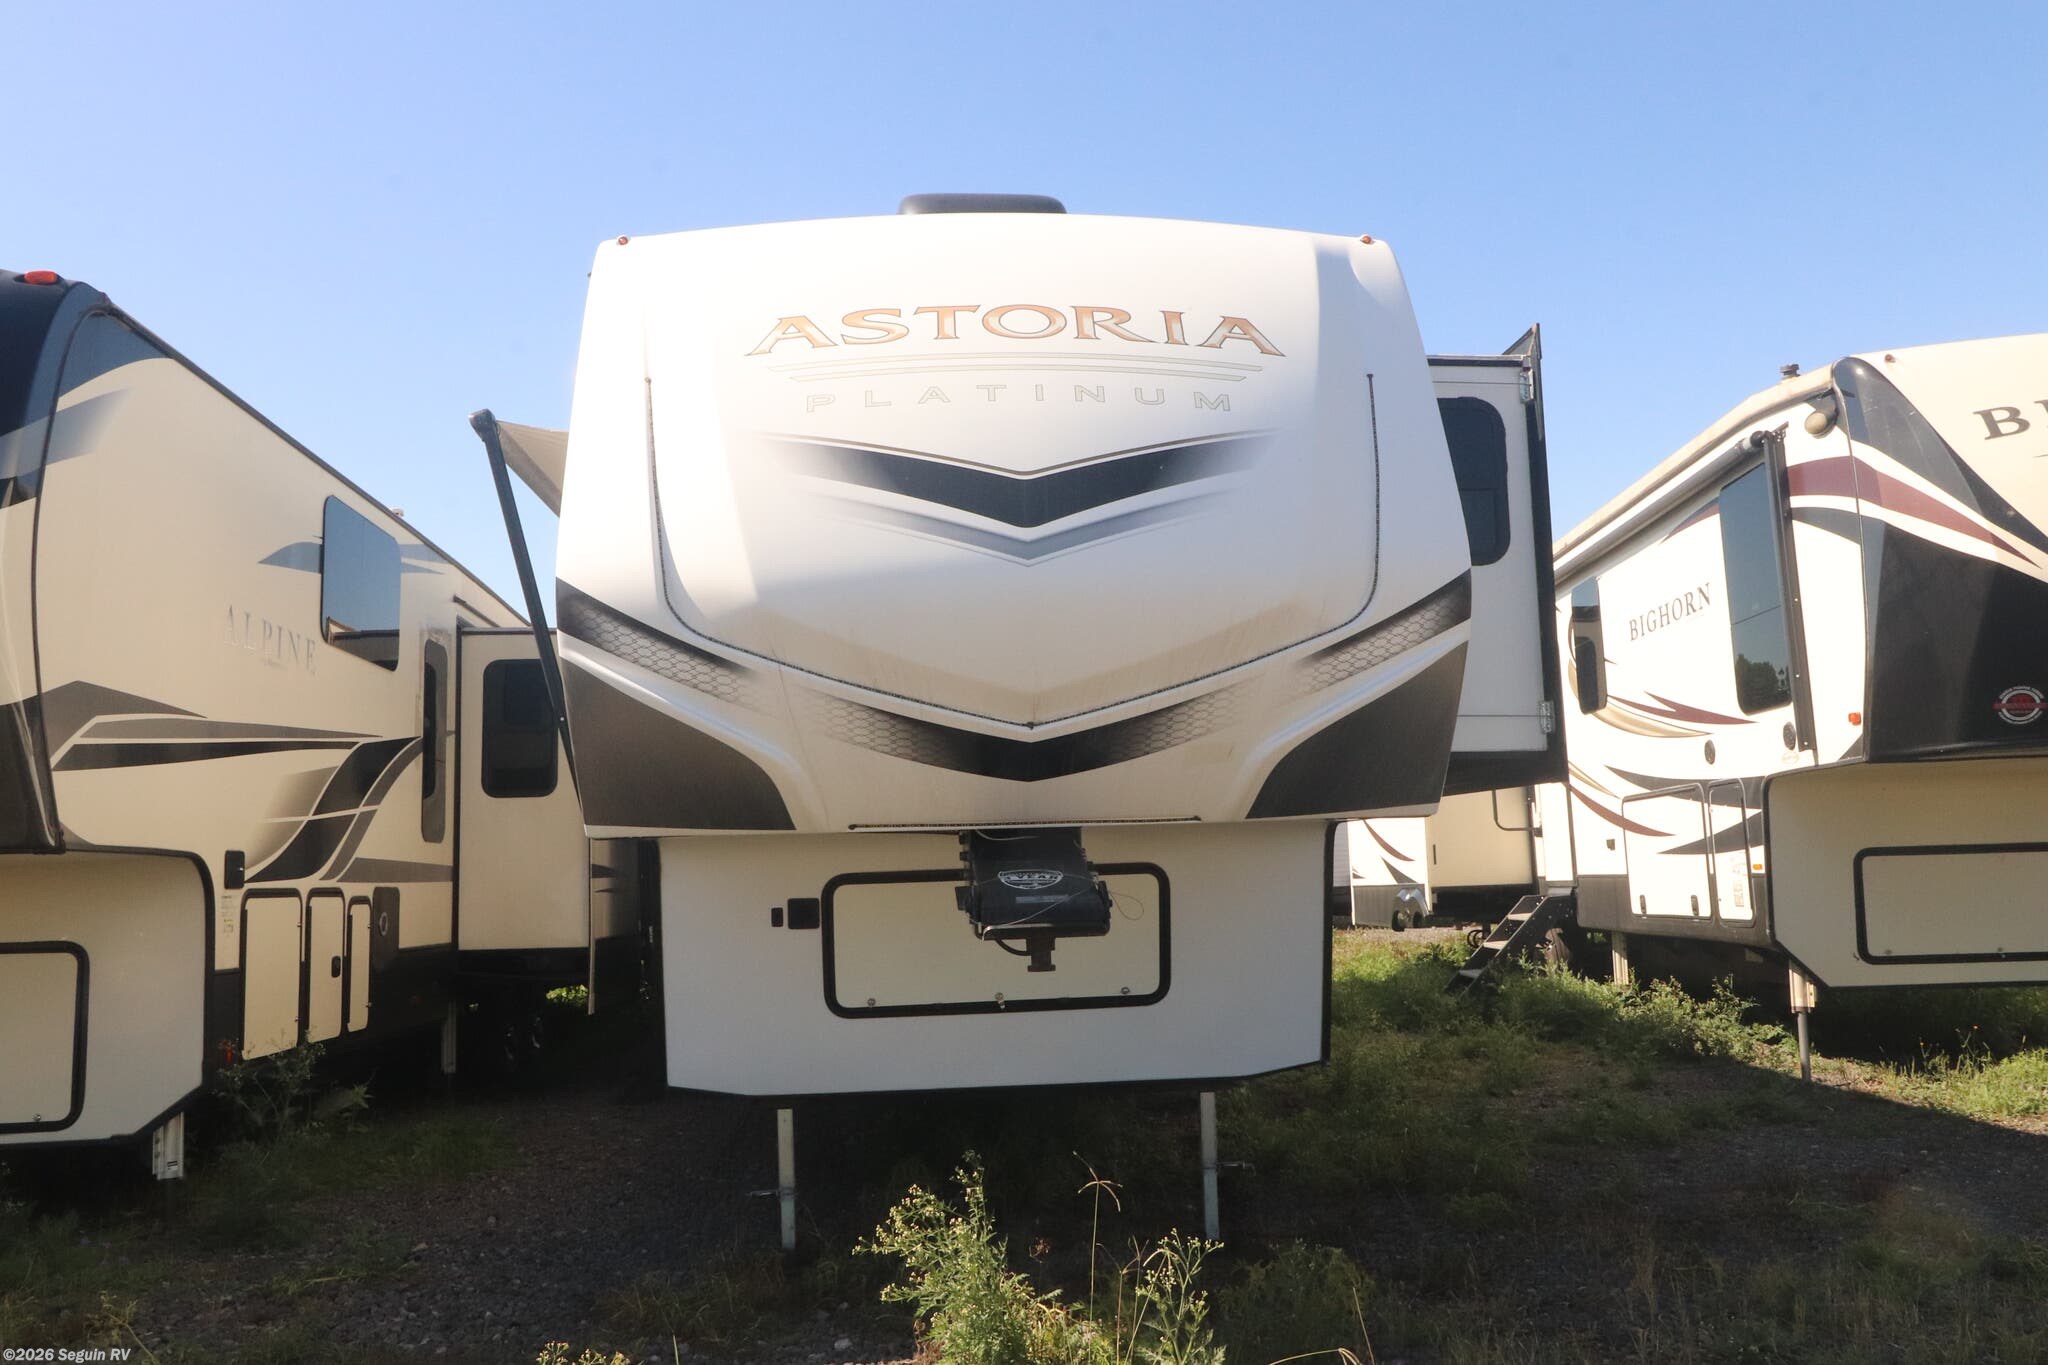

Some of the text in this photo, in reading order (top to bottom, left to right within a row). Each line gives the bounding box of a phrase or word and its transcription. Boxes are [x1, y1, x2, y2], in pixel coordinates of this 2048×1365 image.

[744, 304, 1286, 356] ASTORIA
[807, 383, 1231, 412] PLATINUM
[1973, 399, 2048, 440] B
[1629, 582, 1710, 641] BIGHORN
[224, 604, 318, 677] ALPINE
